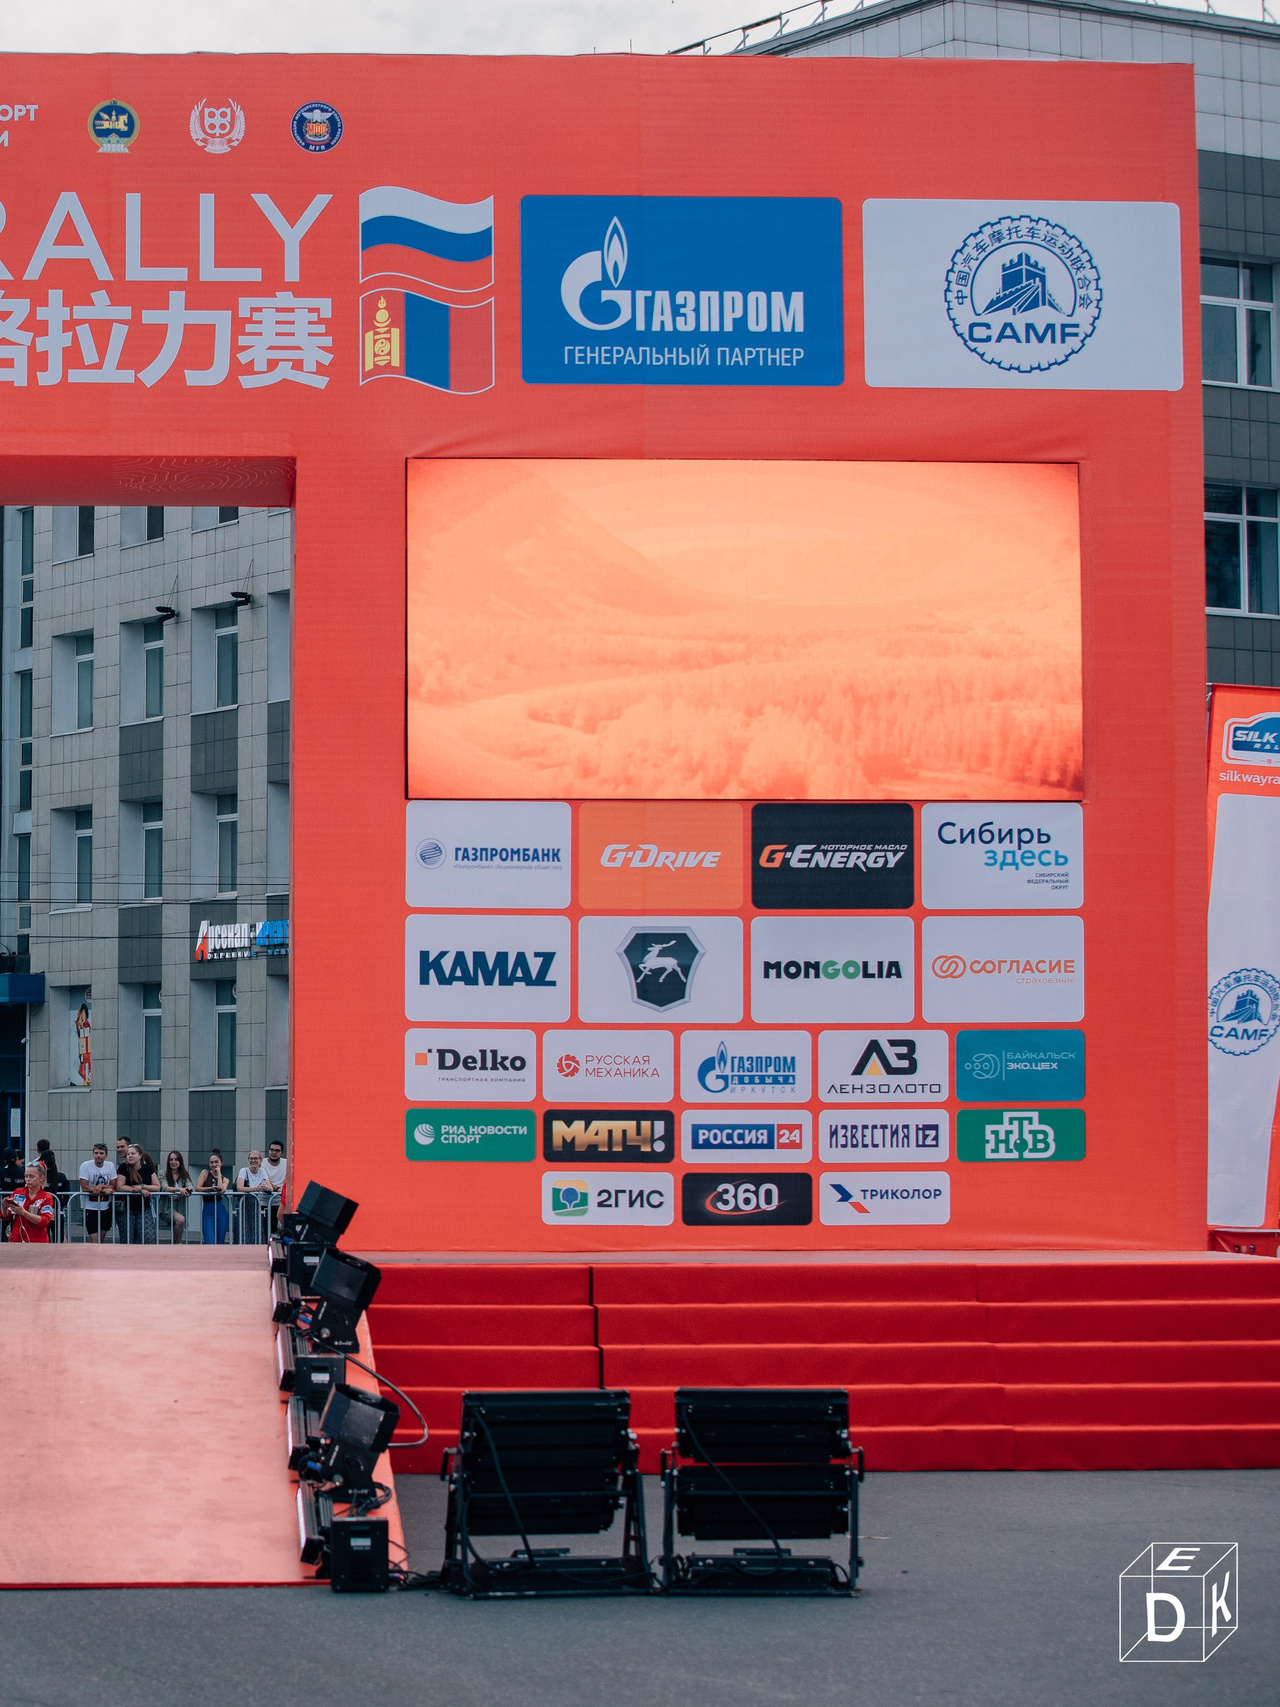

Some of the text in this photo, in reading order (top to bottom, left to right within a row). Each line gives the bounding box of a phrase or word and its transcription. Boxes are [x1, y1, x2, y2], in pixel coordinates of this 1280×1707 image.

[954, 226, 1094, 310] 中国汽车摩托车运动联合会
[634, 290, 805, 333] ГАЗПРОМ
[968, 322, 1080, 344] CAMF
[563, 344, 805, 367] ГЕНЕРАЛЬНЫЙ ПАРТНЕР
[1233, 730, 1279, 743] SILK
[937, 820, 1052, 850] Сибирь
[454, 847, 561, 863] ГАЗПРОМБАНК
[984, 849, 1069, 871] здесь
[419, 950, 557, 987] KAMAZ
[763, 959, 903, 980] MONGOLIA
[969, 959, 1076, 974] СОГЛАСИЕ
[1015, 976, 1076, 985] страхование
[1209, 1026, 1270, 1040] CAMF
[436, 1048, 527, 1072] Delko
[585, 1054, 651, 1065] РУССКАЯ
[1006, 1050, 1076, 1060] БАЙКАЛЬСК
[585, 1066, 660, 1078] МЕХАНИКА
[730, 1056, 796, 1073] ГАЗПРОМ
[1006, 1061, 1058, 1071] ЭКО.ЦЕХ
[732, 1075, 795, 1085] ДОБЫЧА
[827, 1083, 941, 1094] ЛЕНЗОЛОТО
[730, 1086, 796, 1094] ИРКУТСК
[441, 1125, 528, 1135] РИА НОВОСТИ
[552, 1120, 666, 1152] МАТЧ!
[698, 1128, 801, 1145] РОССИЯ 24
[829, 1124, 911, 1148] ИЗВЕСТИЯ
[985, 1111, 1056, 1159] НТВ
[441, 1134, 482, 1144] СПОРТ
[596, 1188, 665, 1209] 2ГИС
[715, 1183, 779, 1211] 360
[860, 1188, 943, 1200] ТРИКОЛОР
